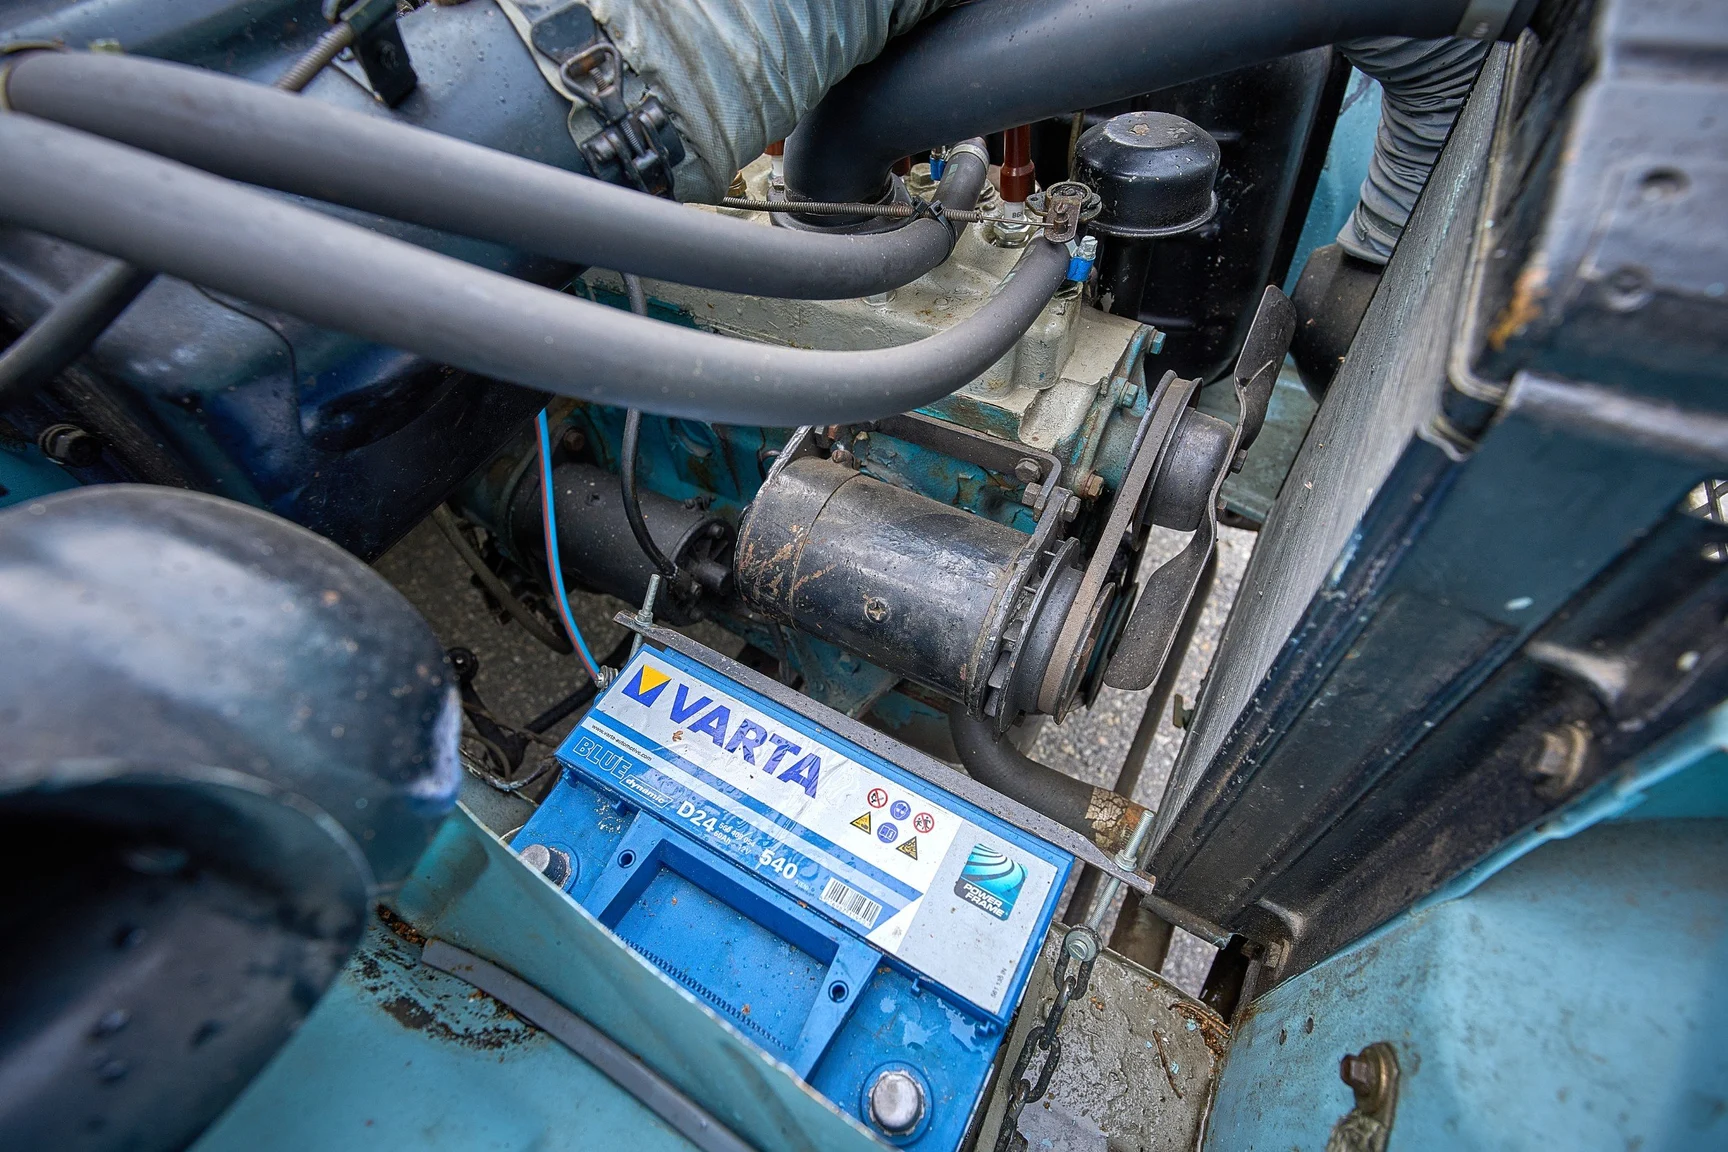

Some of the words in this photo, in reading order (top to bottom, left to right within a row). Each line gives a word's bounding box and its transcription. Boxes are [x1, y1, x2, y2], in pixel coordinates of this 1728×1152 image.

[591, 724, 653, 761] www.varta-automotive.com
[669, 683, 822, 799] VARTA
[572, 736, 633, 780] BLUE
[625, 778, 666, 804] dynamic
[676, 800, 718, 833] D24
[713, 830, 731, 844] 60Ah
[738, 844, 752, 855] 12V
[759, 848, 798, 880] 540
[963, 883, 1003, 907] POWER
[965, 892, 1005, 917] FRAME
